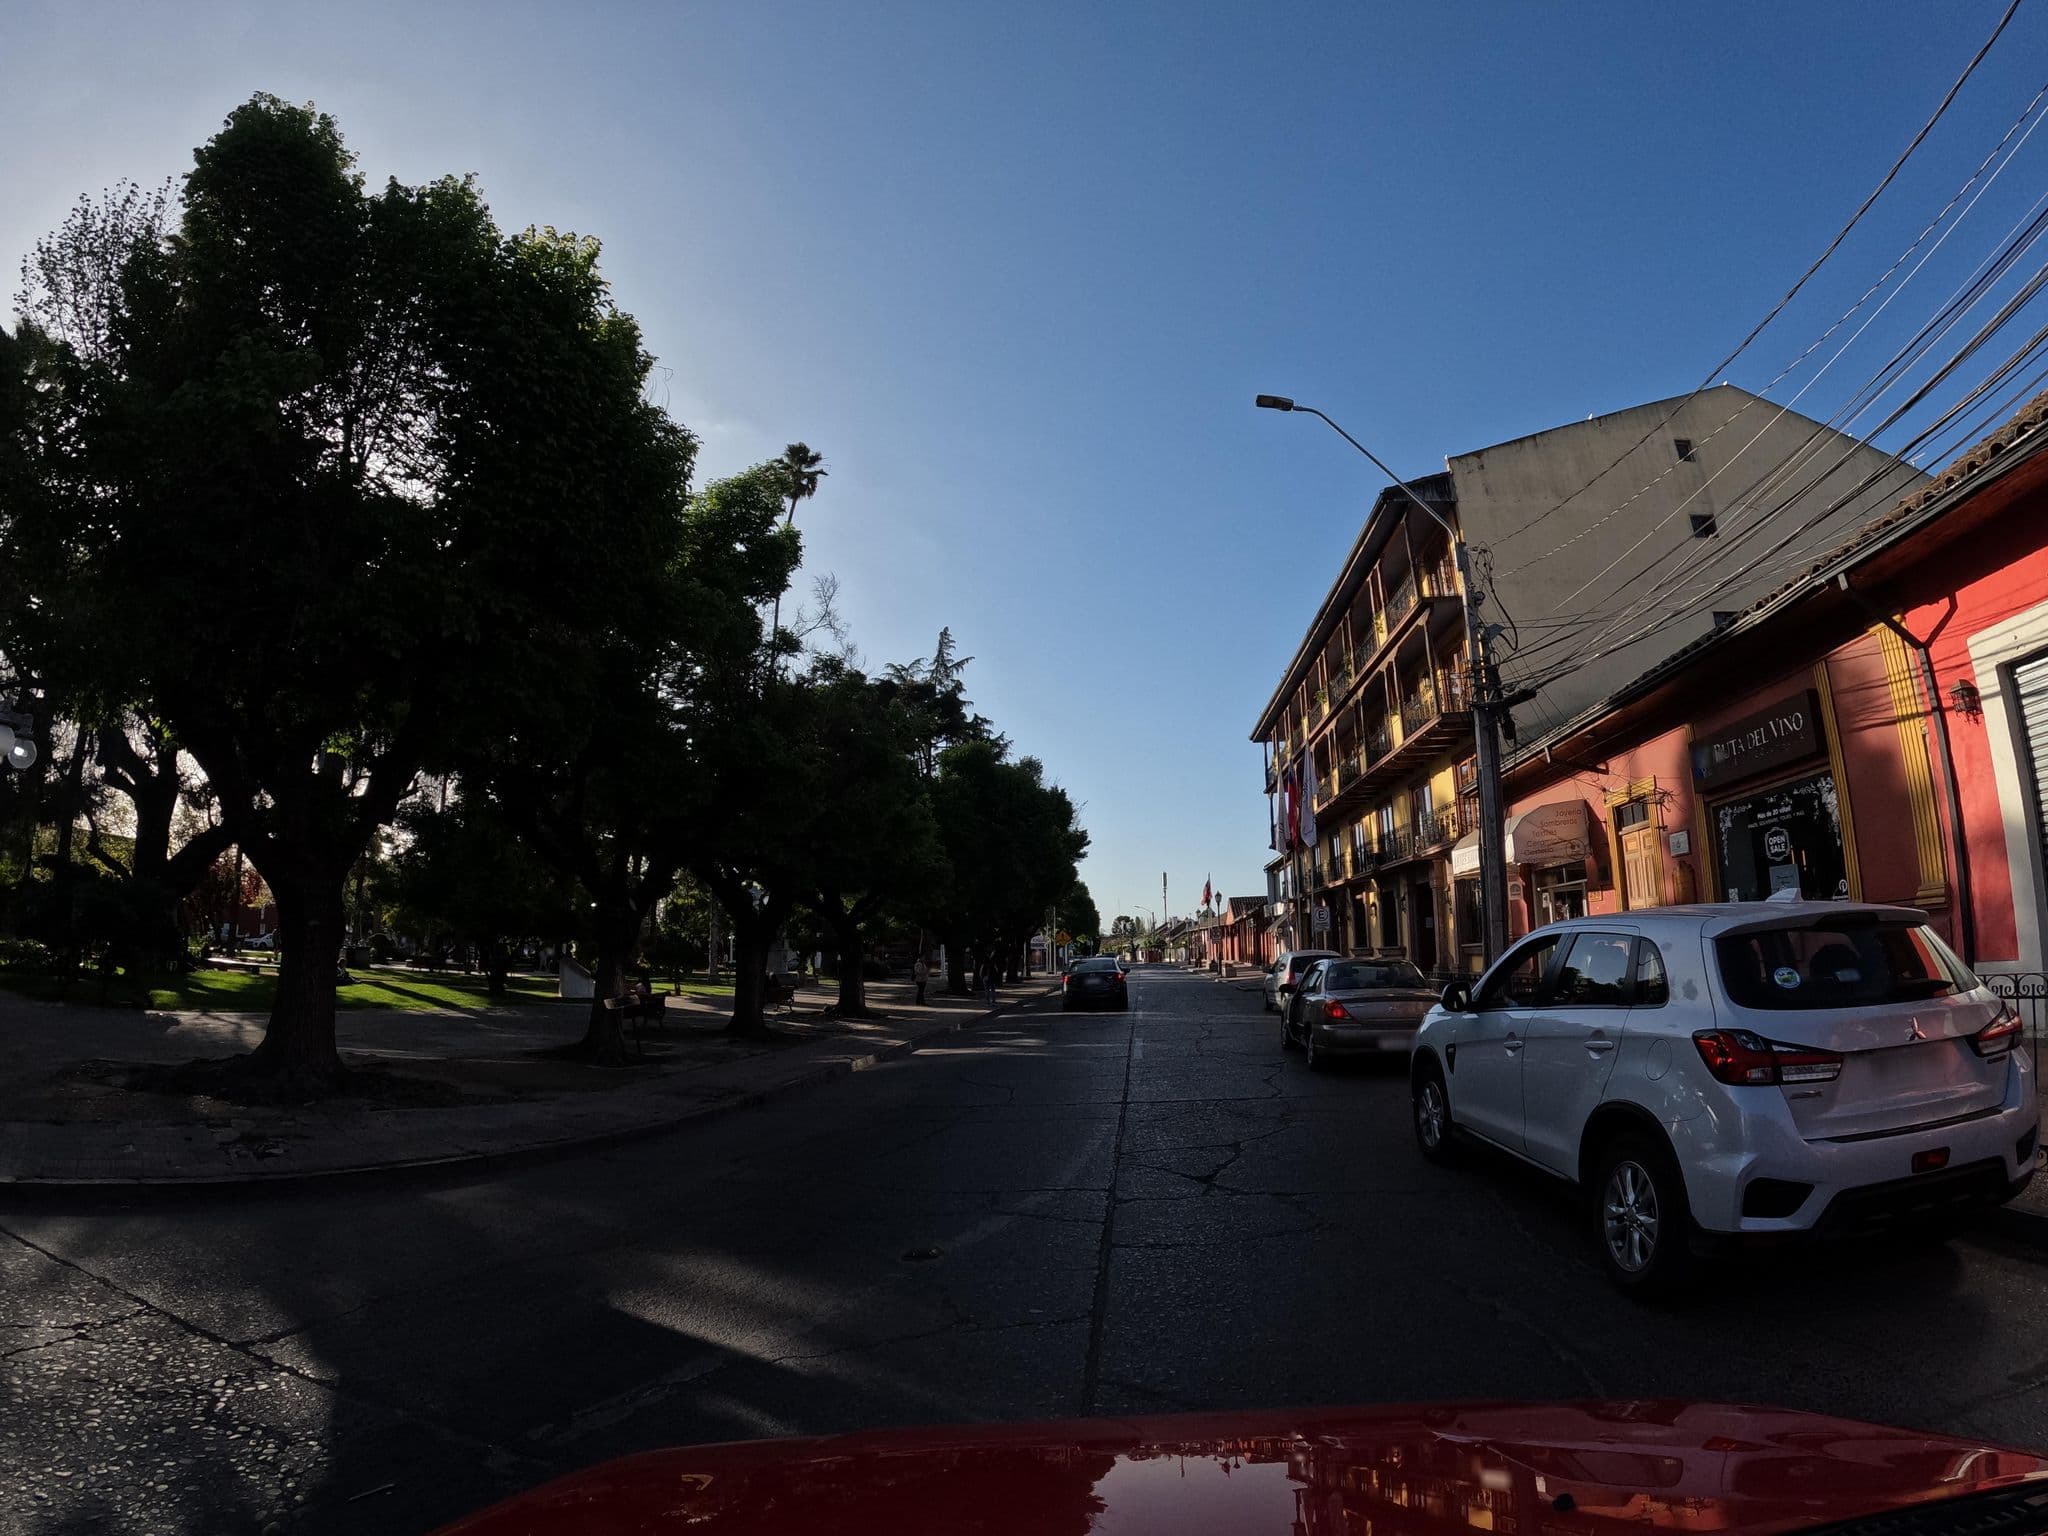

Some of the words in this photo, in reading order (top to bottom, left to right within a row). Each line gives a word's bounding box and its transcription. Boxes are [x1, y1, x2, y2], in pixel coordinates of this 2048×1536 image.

[1746, 727, 1769, 749] DEL
[1768, 712, 1803, 738] VINO
[1768, 835, 1786, 845] OPEN
[1770, 843, 1786, 854] SALE
[1318, 910, 1325, 919] E
